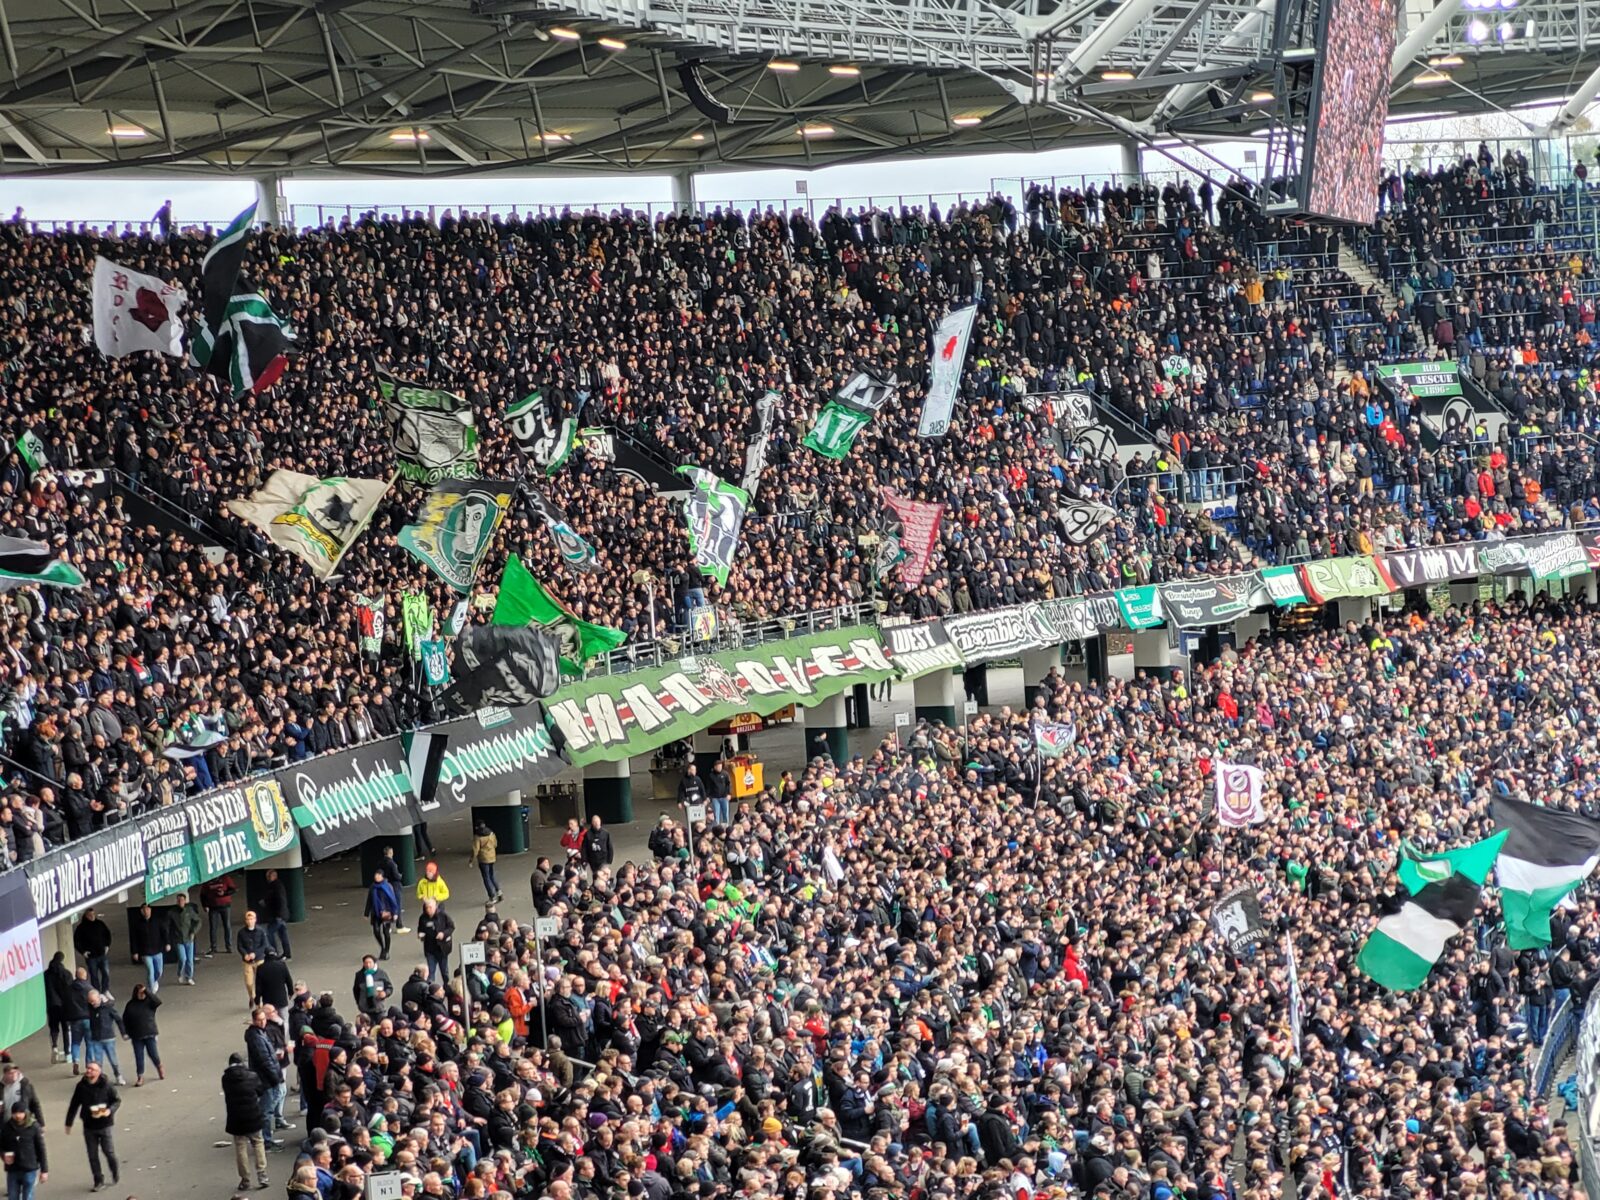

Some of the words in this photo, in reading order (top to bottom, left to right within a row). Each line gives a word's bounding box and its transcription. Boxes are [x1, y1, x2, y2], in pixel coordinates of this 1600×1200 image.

[1169, 357, 1183, 371] 96
[1422, 363, 1441, 373] RED
[1415, 374, 1454, 385] RESCUE
[891, 624, 937, 653] WEST
[950, 615, 1025, 651] Ensemble
[736, 723, 756, 733] BREZELN
[186, 788, 248, 837] PASSION
[203, 831, 252, 875] PRIDE
[28, 867, 59, 919] ROTE
[92, 831, 147, 893] HANNOVER
[380, 1187, 387, 1196] N
[389, 1187, 393, 1195] 1
